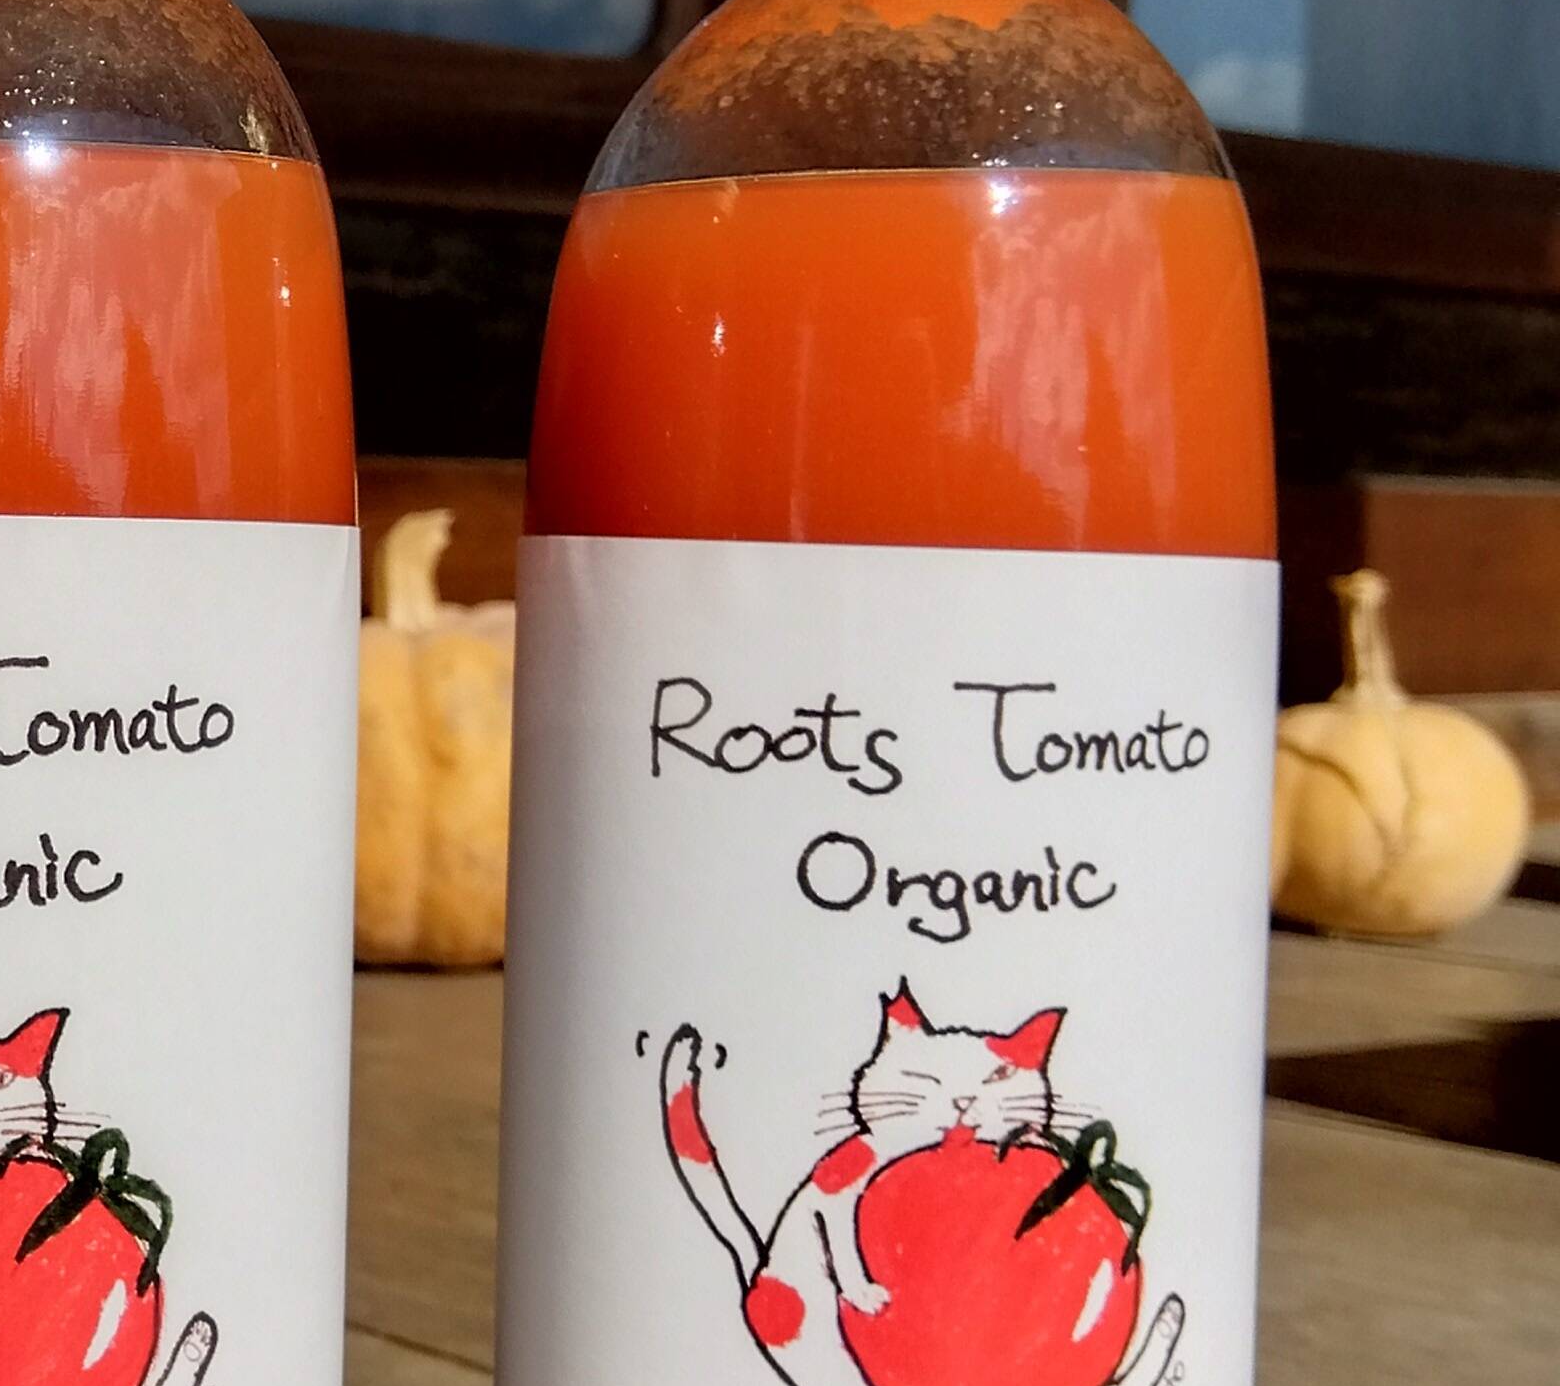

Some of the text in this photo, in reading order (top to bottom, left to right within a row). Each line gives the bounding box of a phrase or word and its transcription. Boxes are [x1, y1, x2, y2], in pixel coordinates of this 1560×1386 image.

[649, 676, 1210, 797] Roots Tomato
[795, 830, 1118, 945] Organic
